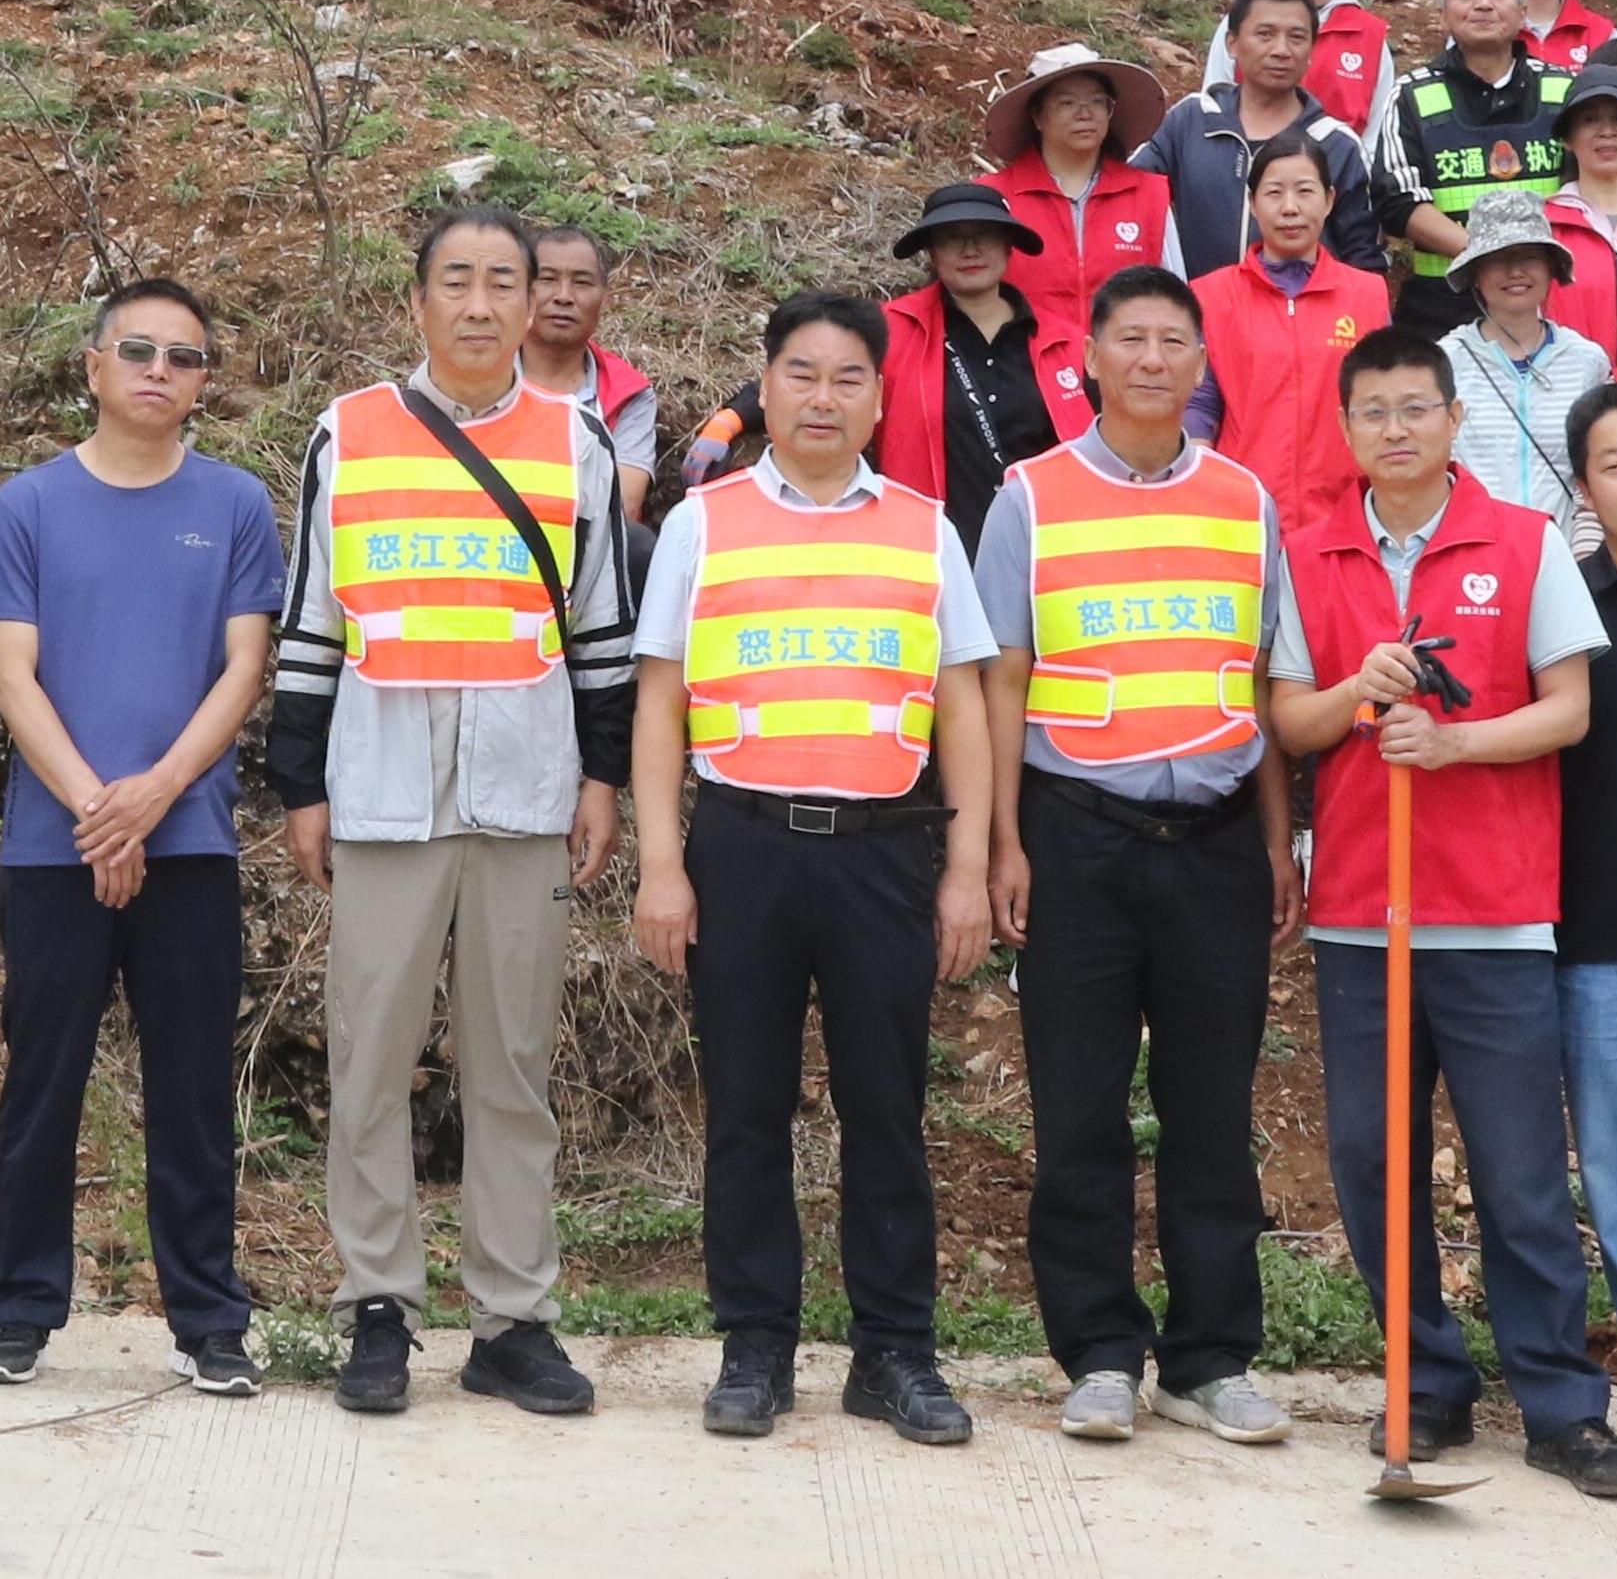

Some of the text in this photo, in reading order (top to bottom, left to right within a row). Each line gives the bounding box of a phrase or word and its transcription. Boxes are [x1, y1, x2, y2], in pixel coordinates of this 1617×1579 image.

[1434, 149, 1486, 181] 交通
[951, 356, 974, 390] SWOOSH
[976, 409, 997, 449] SWOOSH
[366, 532, 531, 575] 怒江交通
[1077, 594, 1237, 637] 怒江交通
[736, 626, 900, 667] 怒江交通
